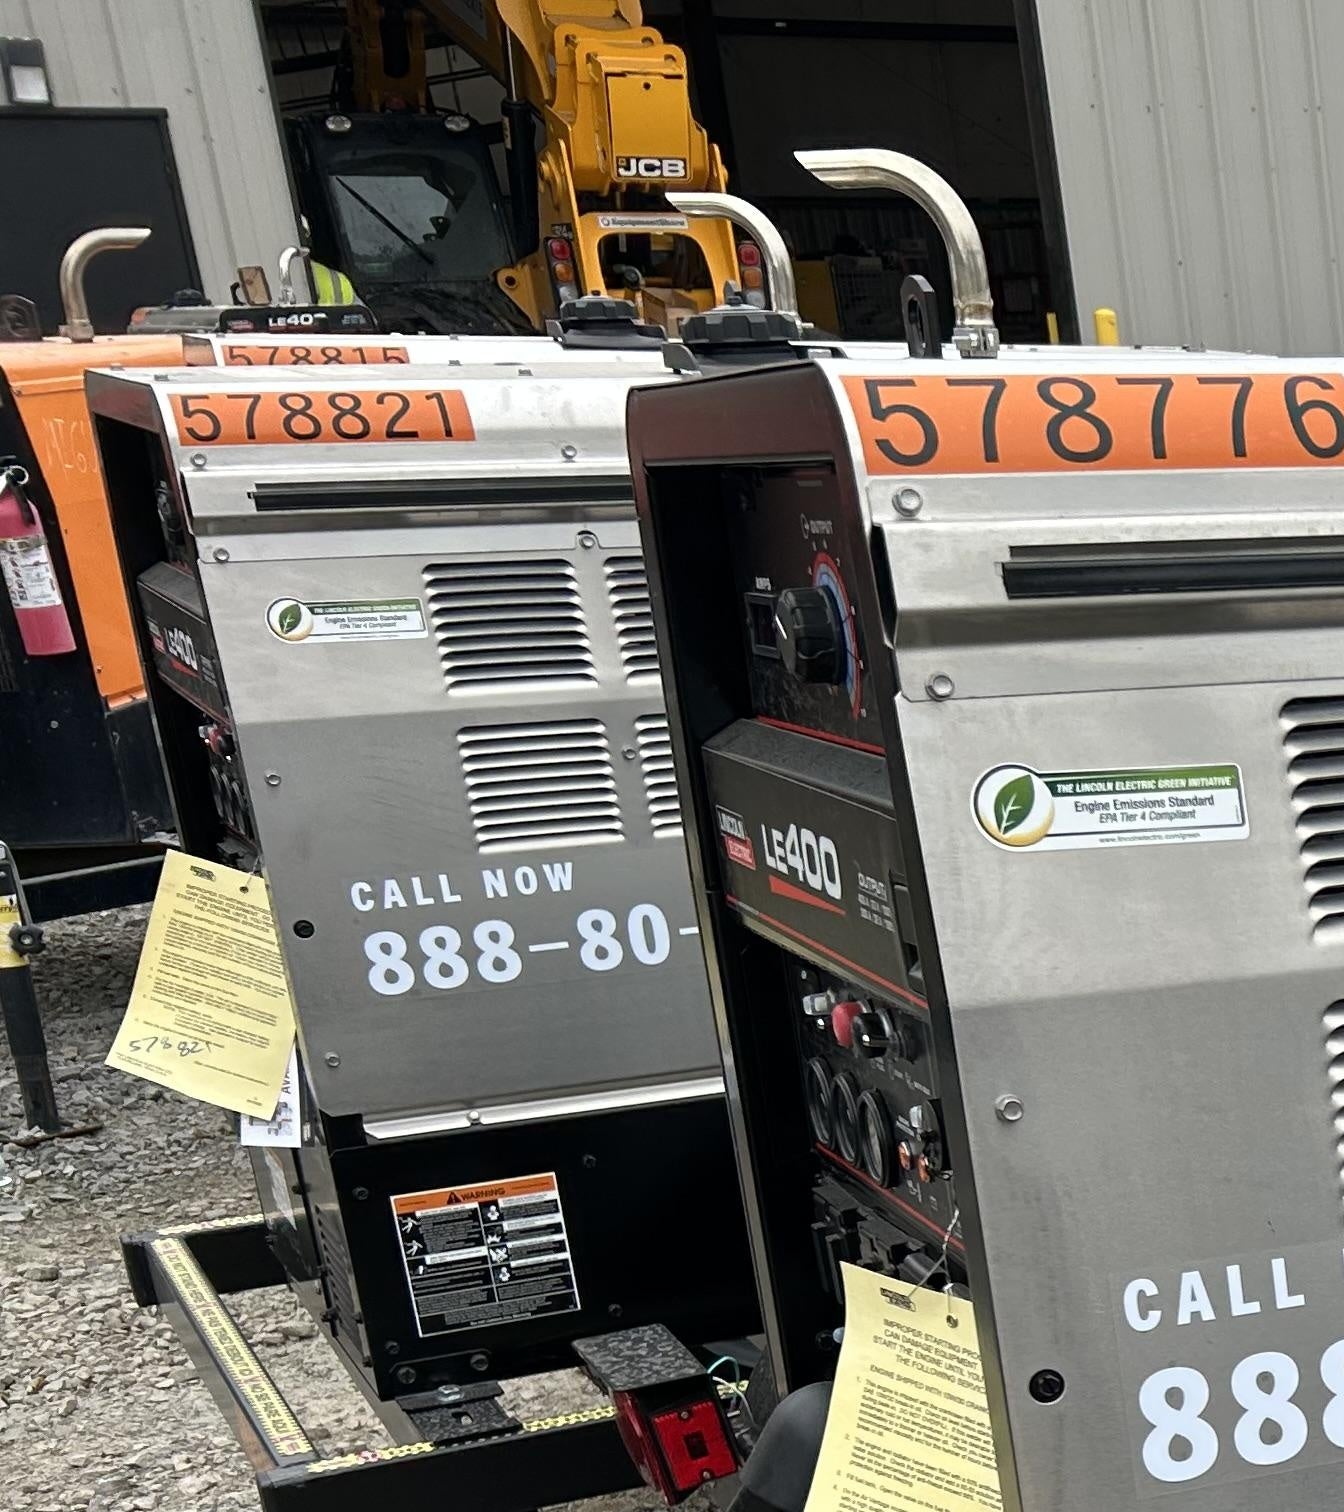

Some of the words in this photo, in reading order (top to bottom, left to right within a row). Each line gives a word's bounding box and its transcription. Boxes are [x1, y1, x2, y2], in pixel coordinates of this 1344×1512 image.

[617, 158, 686, 178] JCB
[228, 346, 407, 365] 578815
[181, 391, 453, 441] 578821
[810, 519, 833, 535] OUTPUT
[1056, 783, 1075, 794] THE
[1076, 780, 1113, 793] LINCOLN
[1115, 778, 1157, 791] ELECTRIC
[1158, 777, 1188, 789] GREEN
[1188, 775, 1232, 788] INITIATIVE
[1074, 799, 1110, 813] Engine
[1113, 796, 1166, 811] Emissions
[1168, 793, 1215, 808] Standard
[1099, 812, 1117, 823] EPA
[1120, 811, 1138, 822] Tier
[1140, 811, 1147, 822] 4
[1148, 808, 1196, 823] Compliant
[761, 823, 841, 900] LE400
[350, 874, 461, 912] CALL
[482, 862, 573, 898] NOW
[461, 1187, 506, 1202] WARNING
[1122, 1255, 1305, 1333] CALL
[882, 1319, 924, 1339] IMPROPER
[922, 1333, 962, 1353] STARTING
[883, 1329, 902, 1340] CAN
[900, 1335, 934, 1353] DAMAGE
[872, 1335, 898, 1349] START
[898, 1345, 915, 1356] THE
[913, 1351, 944, 1368] ENGINE
[943, 1362, 966, 1376] UNTIL
[869, 1364, 896, 1379] ENGINE
[895, 1374, 925, 1390] SHIPPED
[924, 1384, 943, 1396] WITH
[894, 1355, 912, 1366] THE
[911, 1361, 957, 1383] FOLLOWING
